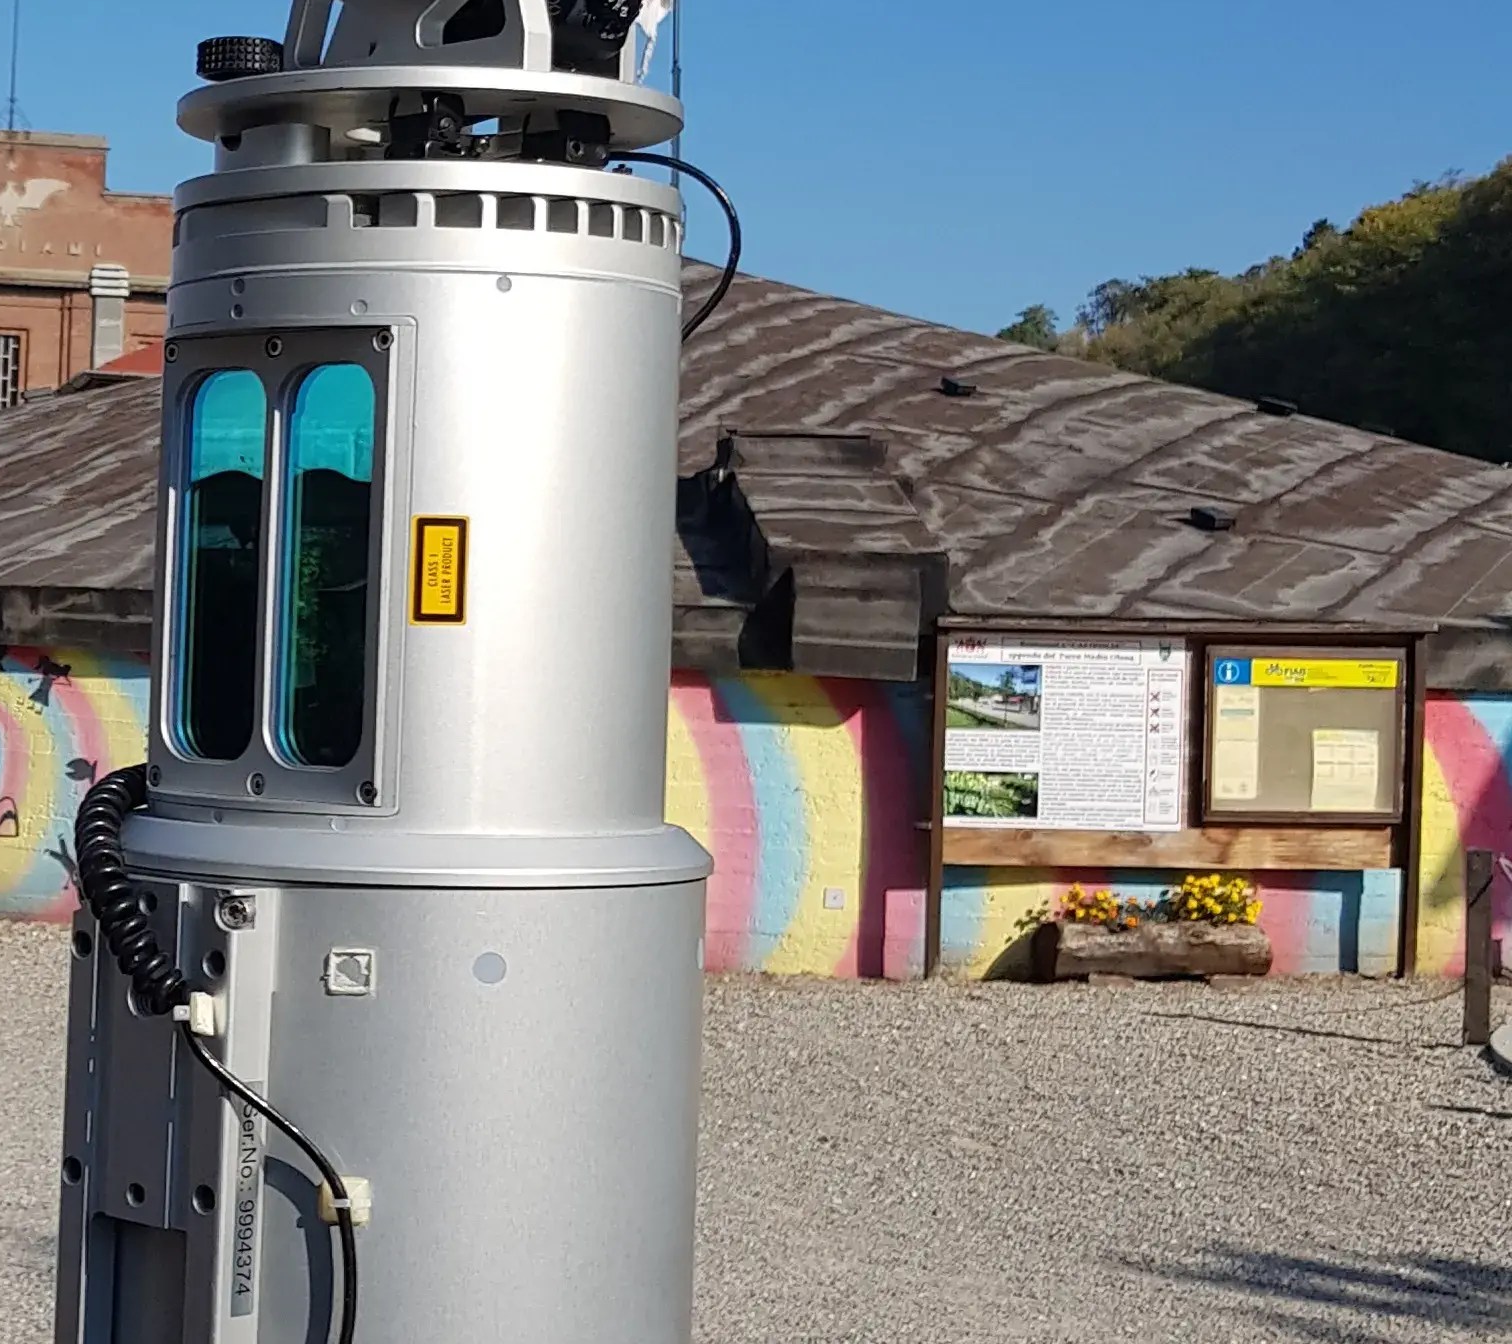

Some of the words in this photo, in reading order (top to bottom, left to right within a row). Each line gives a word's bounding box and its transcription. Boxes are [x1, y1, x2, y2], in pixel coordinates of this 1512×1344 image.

[441, 537, 454, 575] PRODUCT
[428, 561, 439, 588] CLASS
[440, 579, 452, 604] LASER
[235, 1198, 256, 1297] 9994374
